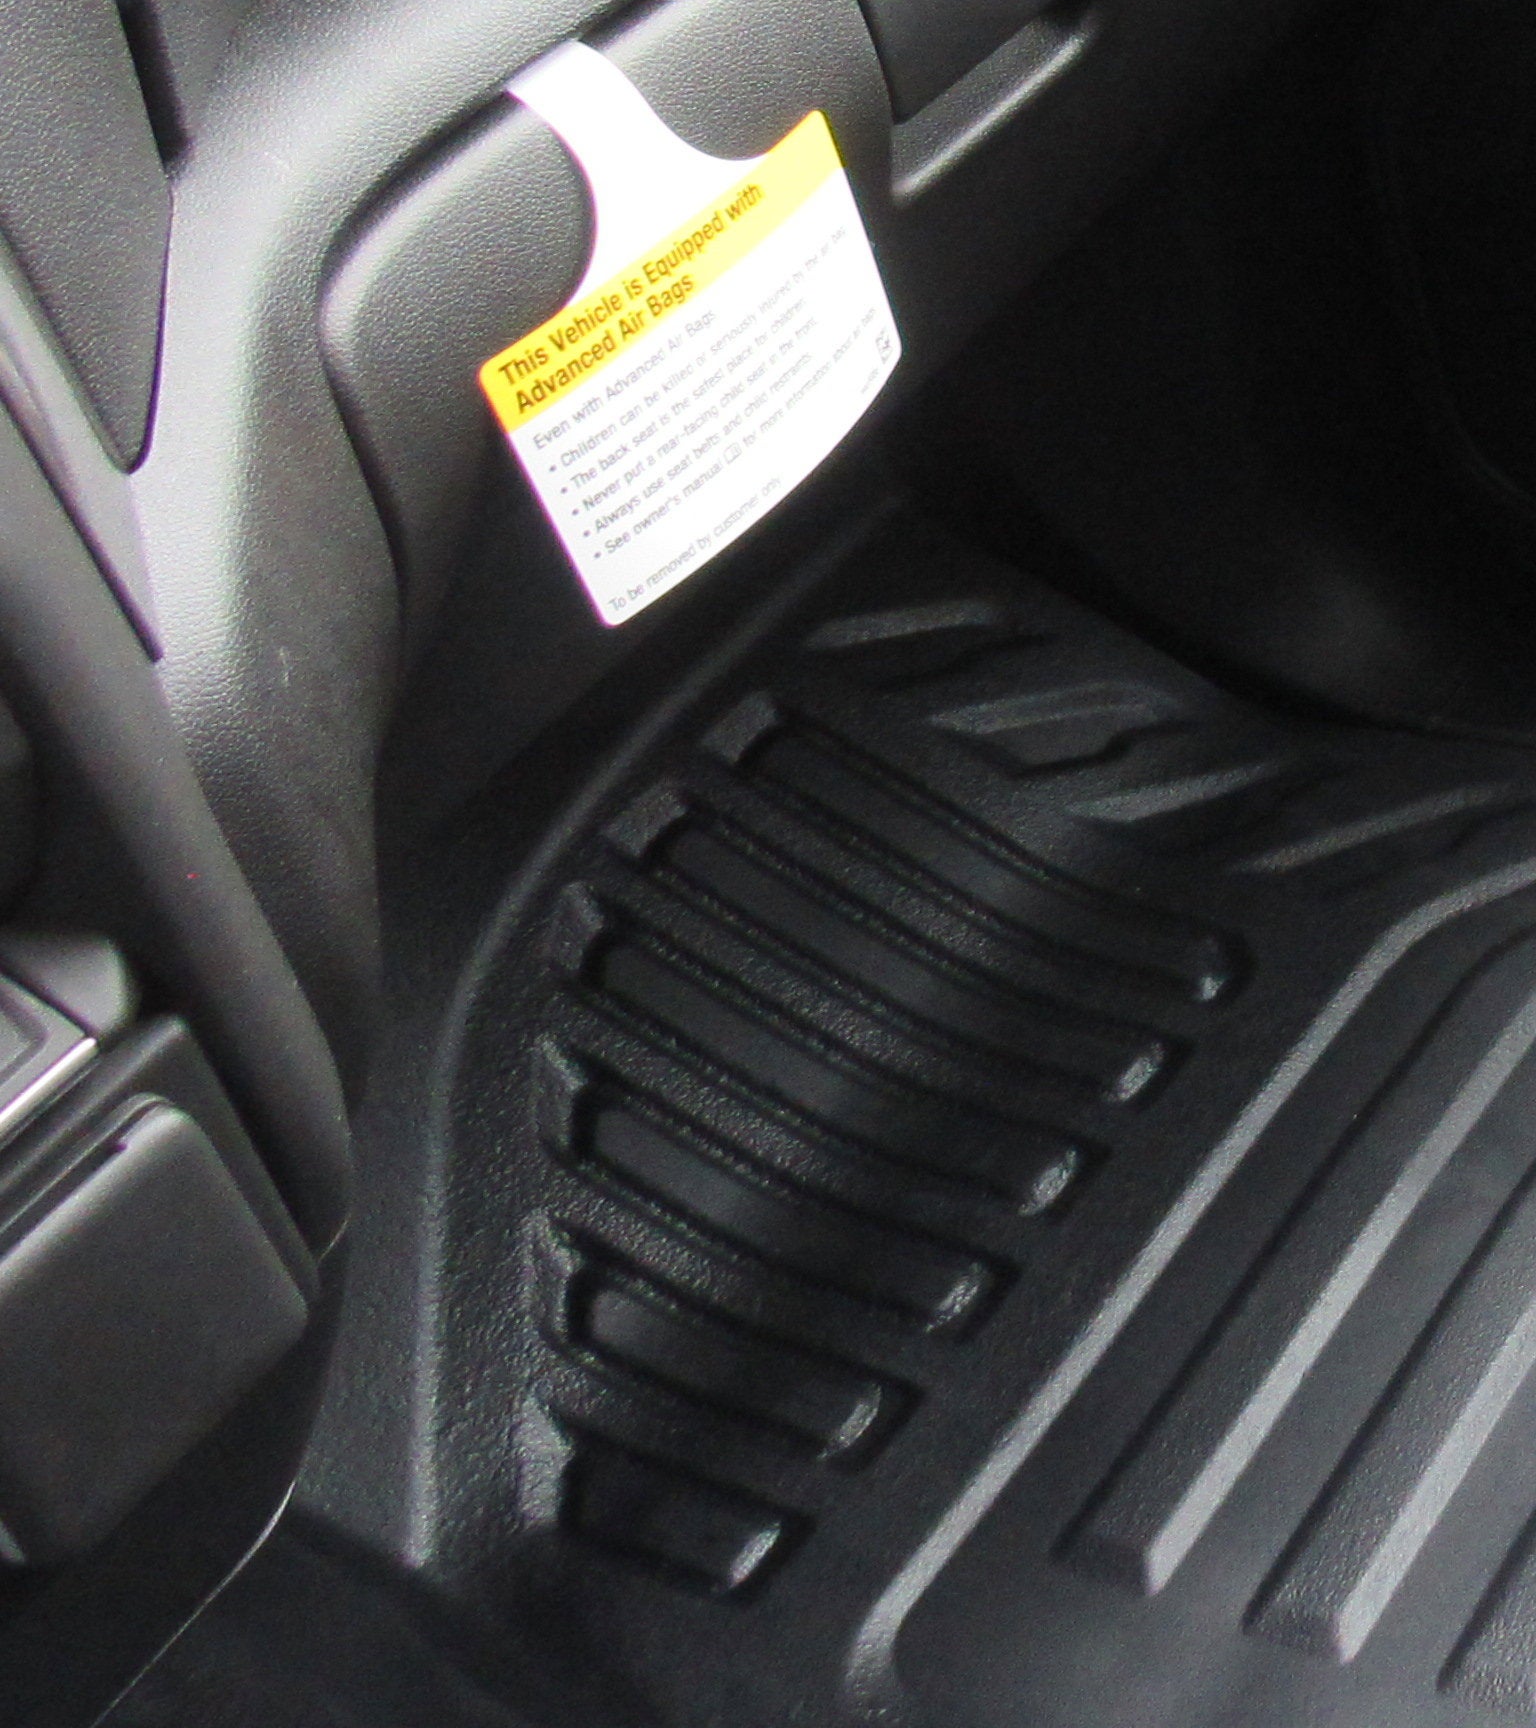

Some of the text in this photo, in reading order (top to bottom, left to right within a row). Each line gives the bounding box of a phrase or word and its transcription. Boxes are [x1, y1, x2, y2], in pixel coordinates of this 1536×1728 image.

[500, 183, 764, 389] This Vehicle is Equipped with
[512, 273, 696, 416] Advanced Air Bags
[533, 416, 572, 451] Even
[571, 394, 605, 426] with
[604, 346, 667, 402] Advanced
[685, 306, 717, 339] Bags
[560, 422, 618, 469] Children
[619, 403, 644, 428] can
[644, 389, 661, 409] be
[571, 464, 599, 490] The
[598, 442, 631, 472] back
[631, 421, 659, 449] seat
[671, 395, 692, 418] the
[582, 478, 623, 513] Never
[623, 460, 646, 486] put
[594, 493, 642, 534] Always
[643, 476, 666, 500] use
[667, 454, 693, 481] seat
[604, 530, 633, 555] See
[632, 493, 682, 538] owner's
[609, 593, 629, 613] To
[627, 582, 646, 602] be
[646, 542, 698, 589] removed
